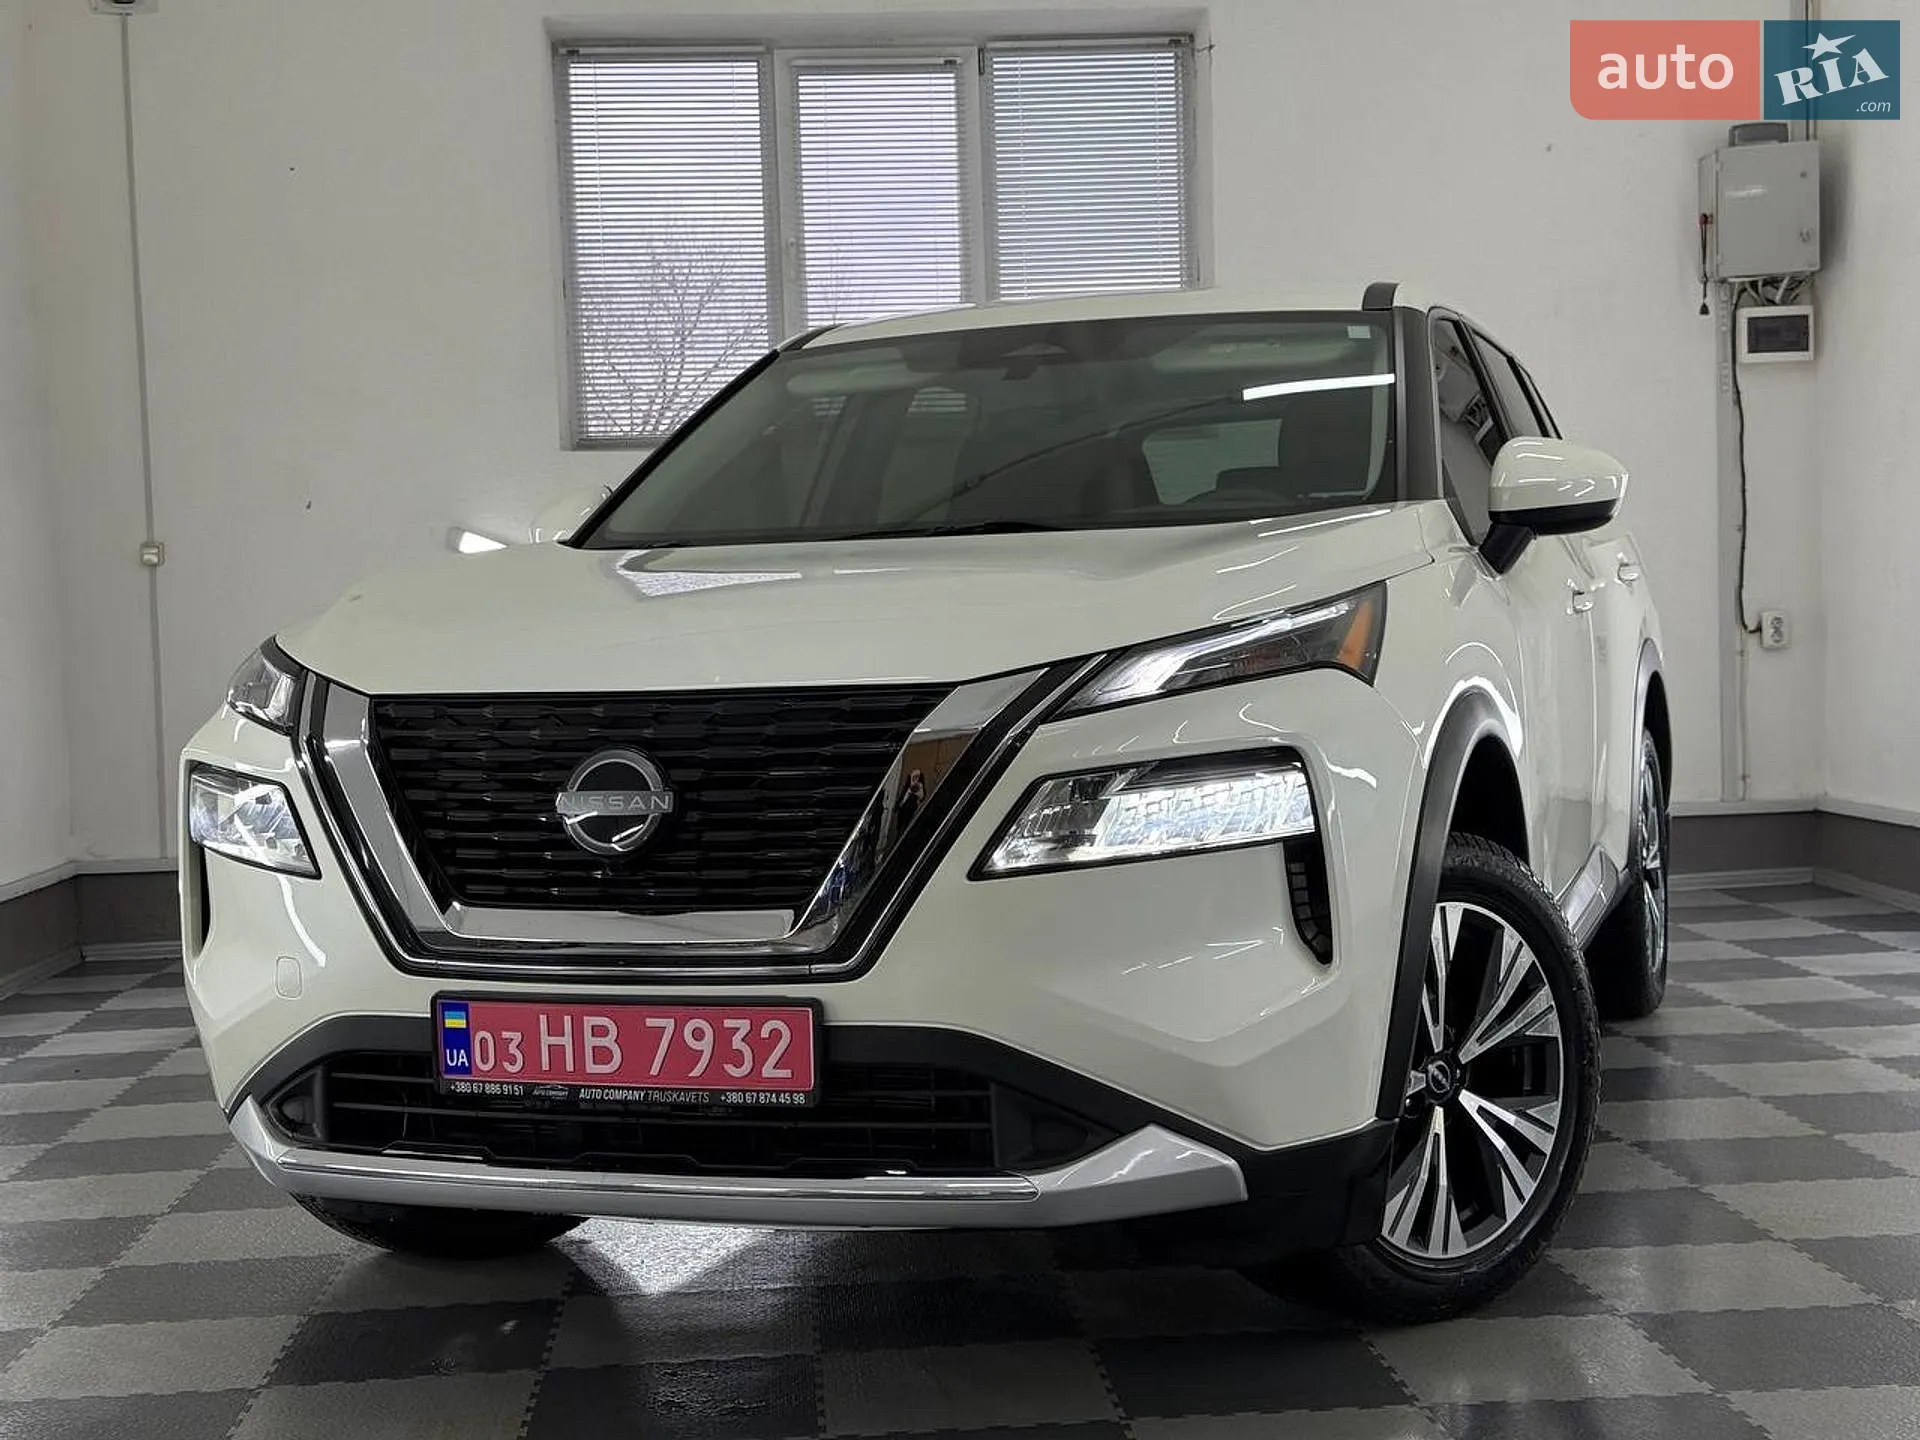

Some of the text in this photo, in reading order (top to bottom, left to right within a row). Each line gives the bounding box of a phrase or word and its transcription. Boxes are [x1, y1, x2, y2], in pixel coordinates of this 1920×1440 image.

[560, 795, 670, 810] NISSAN
[474, 1014, 793, 1079] 03 HB 7932
[446, 1049, 469, 1067] UA
[450, 1081, 472, 1093] +380
[579, 1088, 602, 1100] AUTO
[603, 1088, 646, 1101] COMPANY
[648, 1090, 710, 1103] TRUSKAVETS
[720, 1092, 744, 1104] +380
[745, 1092, 757, 1104] 67
[758, 1092, 777, 1104] 874
[778, 1092, 790, 1104] 45
